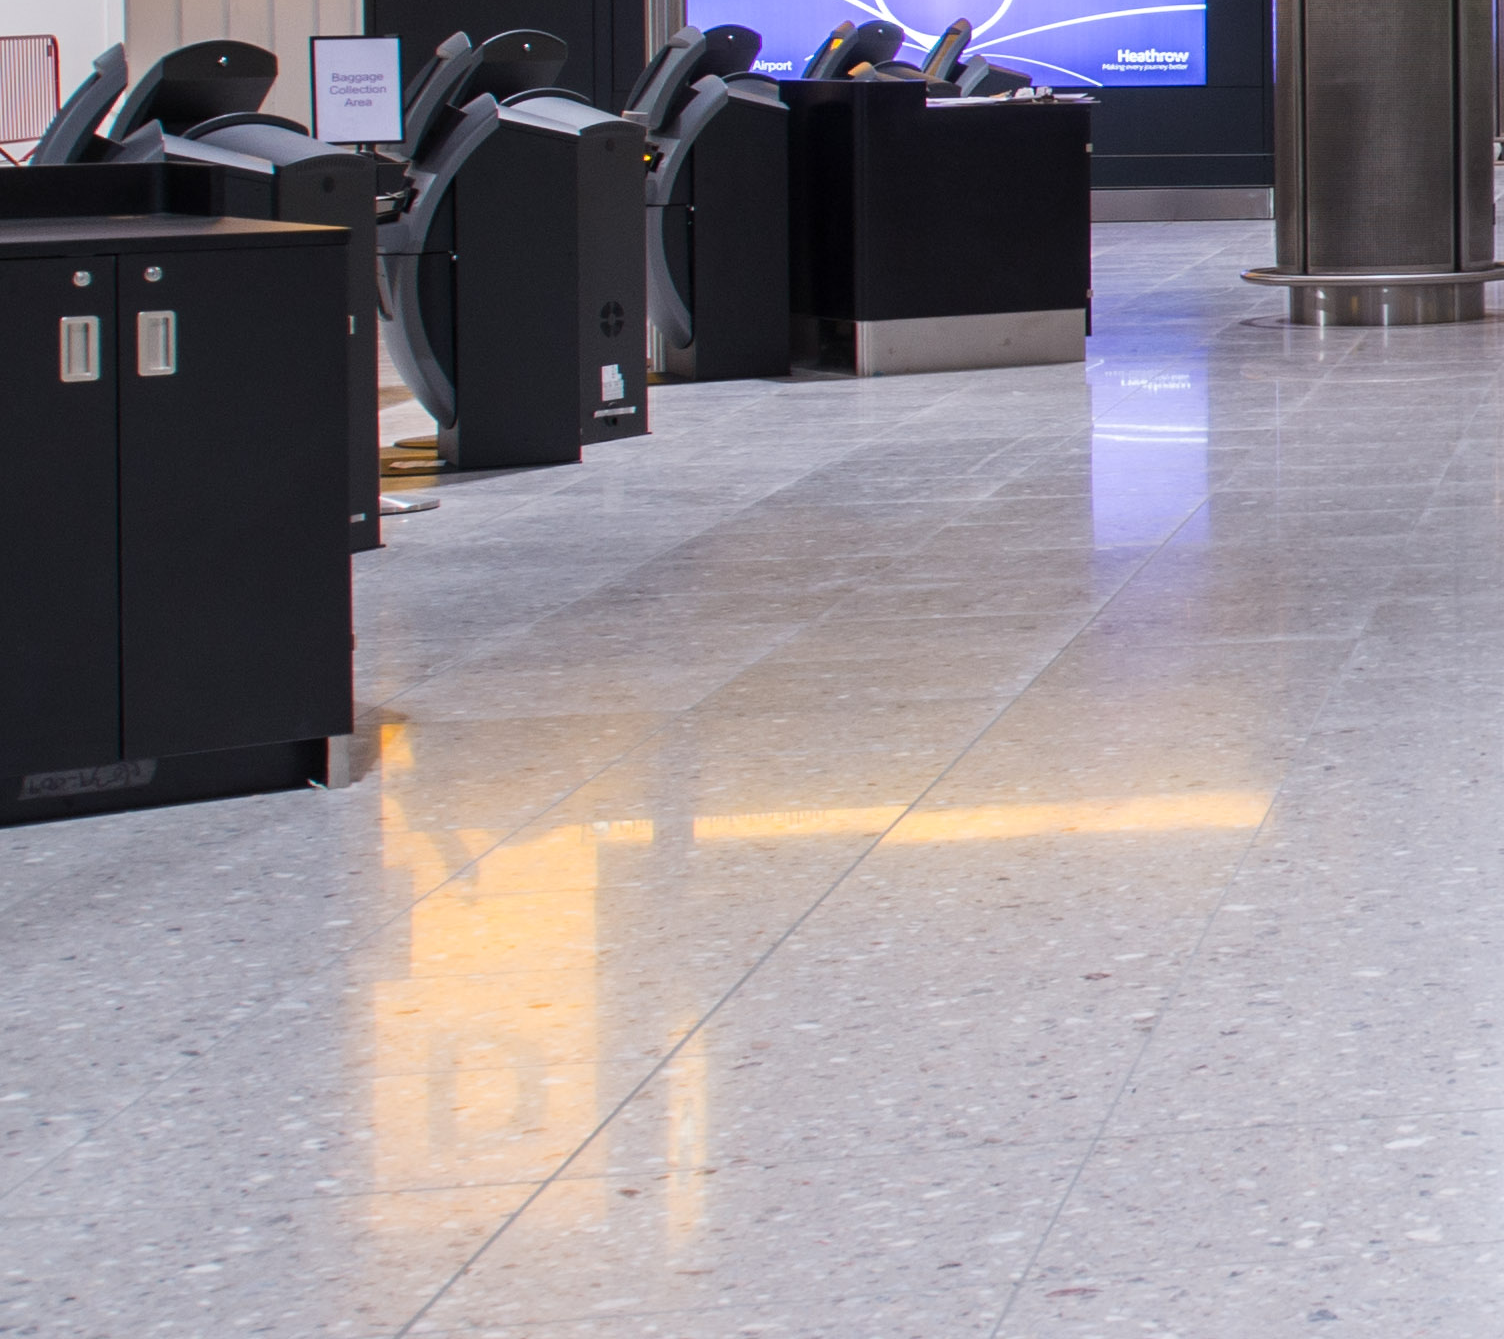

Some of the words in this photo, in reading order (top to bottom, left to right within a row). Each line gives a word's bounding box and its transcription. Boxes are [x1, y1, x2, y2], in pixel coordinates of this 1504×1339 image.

[1117, 48, 1190, 63] Heathrow
[752, 59, 793, 73] Airport
[331, 72, 385, 84] Baggage
[329, 84, 387, 95] Collection
[343, 97, 373, 107] Area
